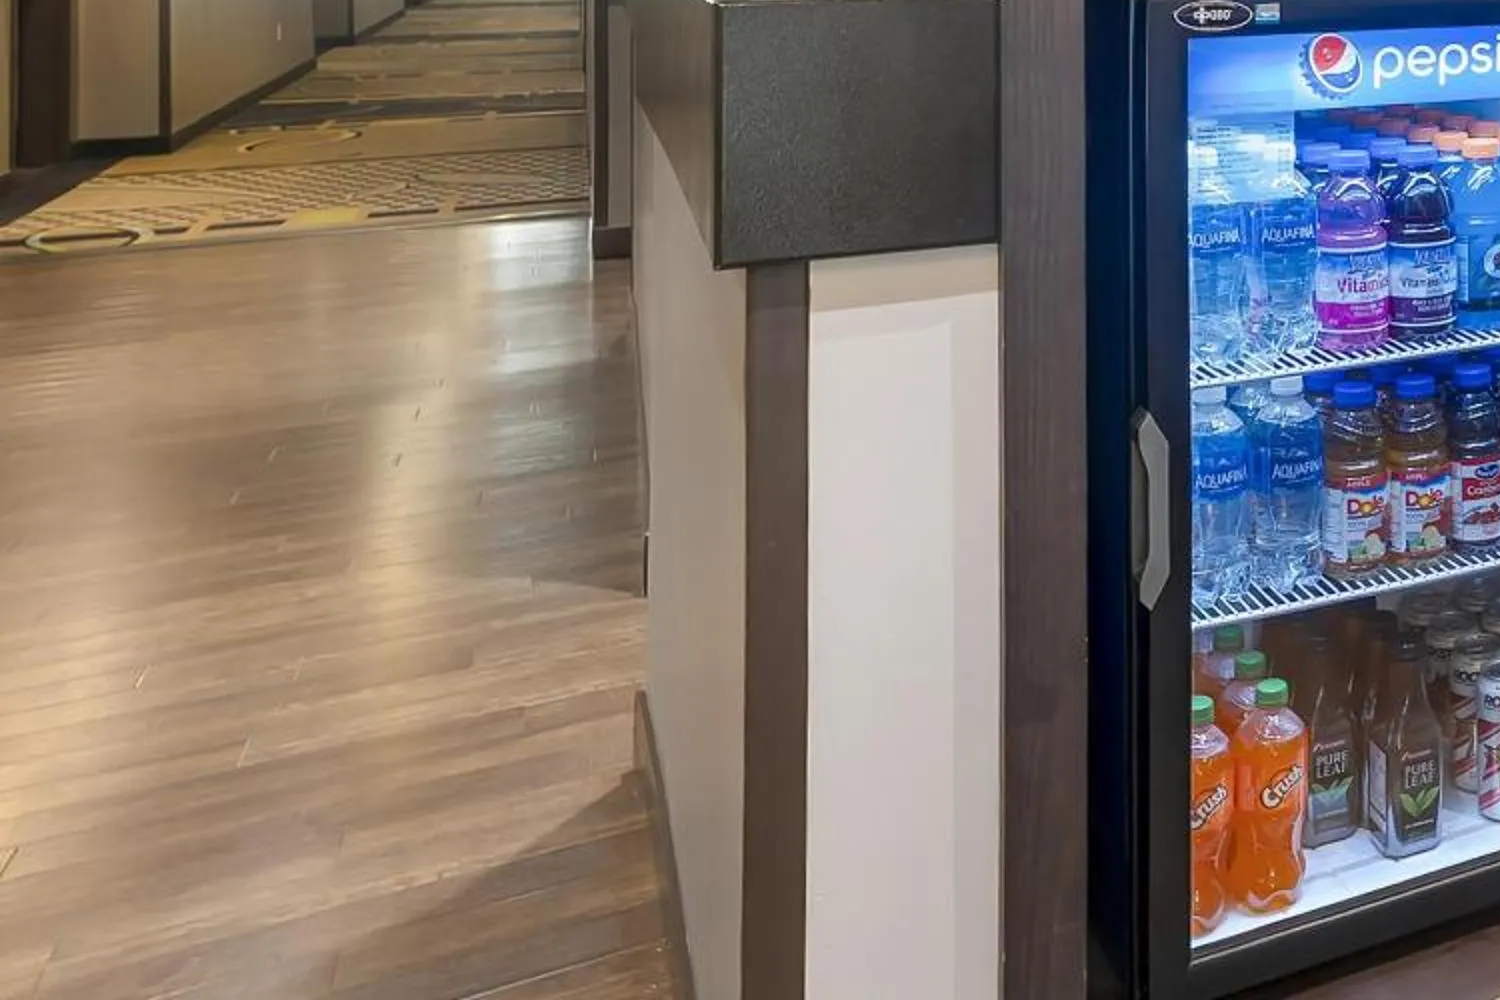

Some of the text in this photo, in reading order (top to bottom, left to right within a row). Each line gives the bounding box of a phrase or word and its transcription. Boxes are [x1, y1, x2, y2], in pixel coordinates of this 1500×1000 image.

[1261, 223, 1316, 243] AQUAFINA
[1316, 749, 1349, 766] PURE
[1405, 760, 1437, 777] PURE
